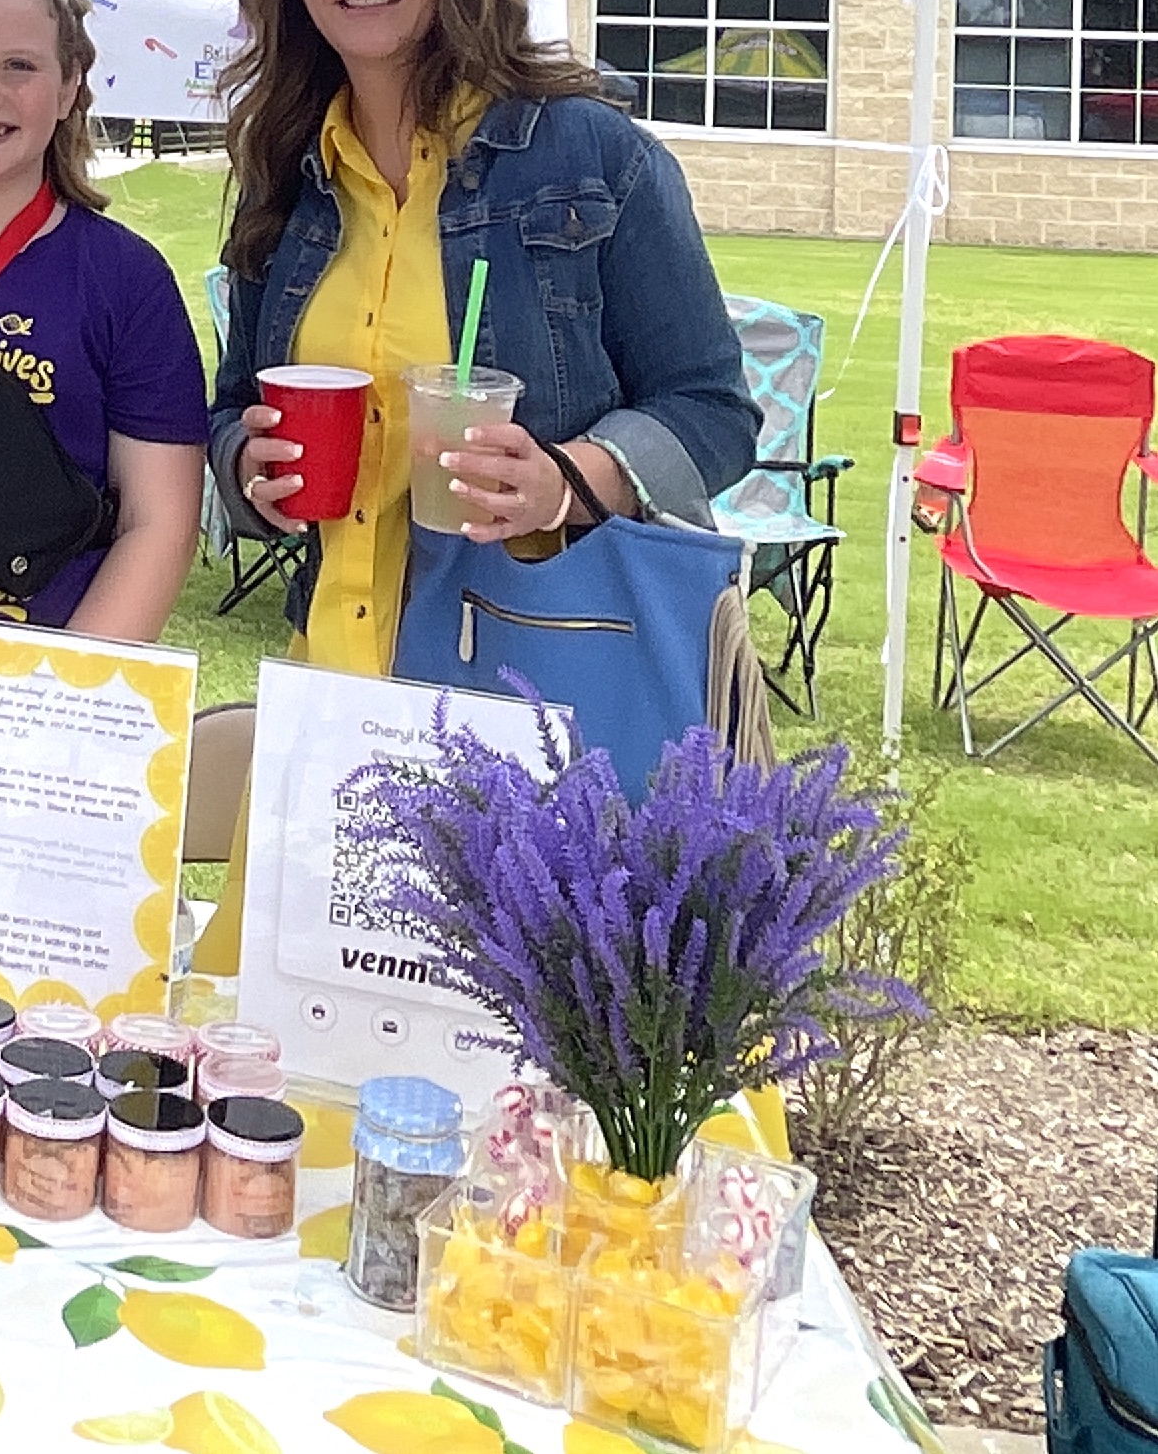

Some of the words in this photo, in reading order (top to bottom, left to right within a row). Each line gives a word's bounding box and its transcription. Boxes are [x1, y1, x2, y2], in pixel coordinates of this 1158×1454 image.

[362, 720, 414, 745] Cheryl
[12, 916, 31, 925] was
[32, 919, 82, 937] refreshing
[83, 928, 102, 939] and
[11, 931, 29, 943] way
[31, 934, 42, 943] to
[44, 937, 65, 948] wake
[69, 942, 82, 952] up
[82, 944, 92, 952] in
[94, 945, 110, 956] the
[28, 950, 46, 960] and
[83, 958, 109, 971] after
